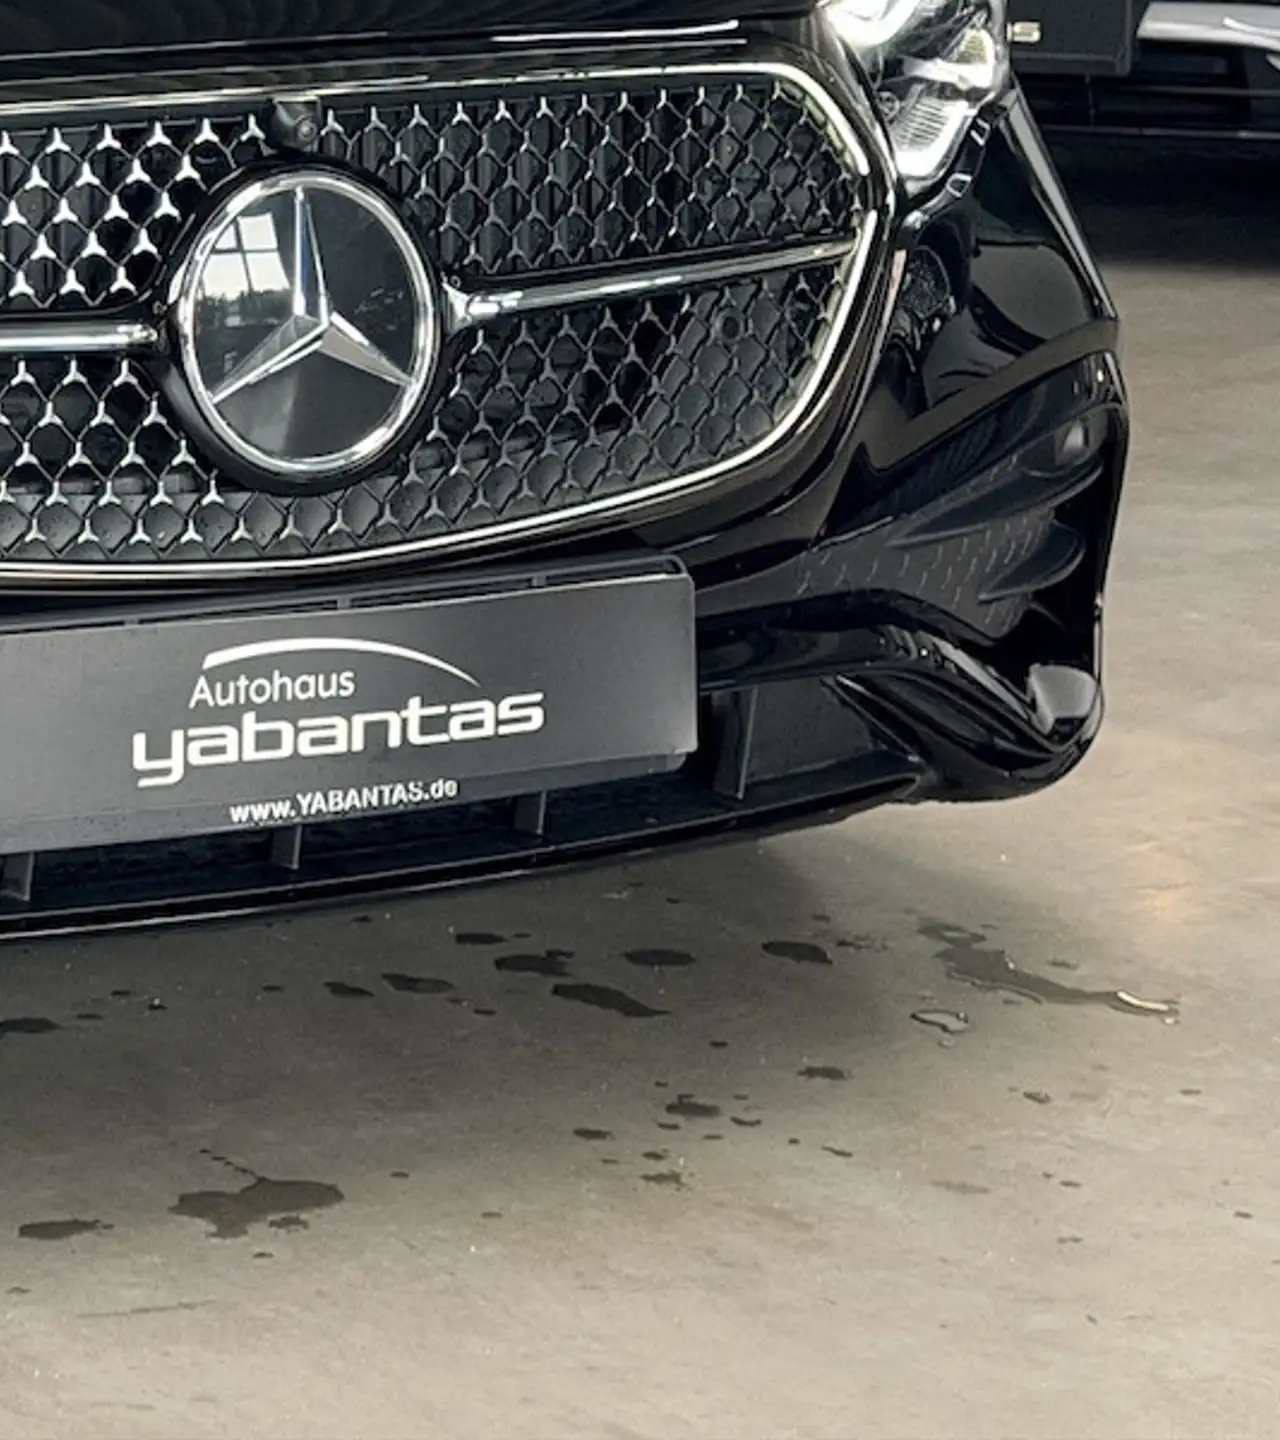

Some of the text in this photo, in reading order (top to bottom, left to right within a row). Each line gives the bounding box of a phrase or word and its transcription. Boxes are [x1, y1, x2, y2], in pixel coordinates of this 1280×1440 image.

[189, 670, 355, 709] Autohaus
[132, 691, 545, 788] yabantas
[229, 778, 459, 824] www.YABANTAS.de
